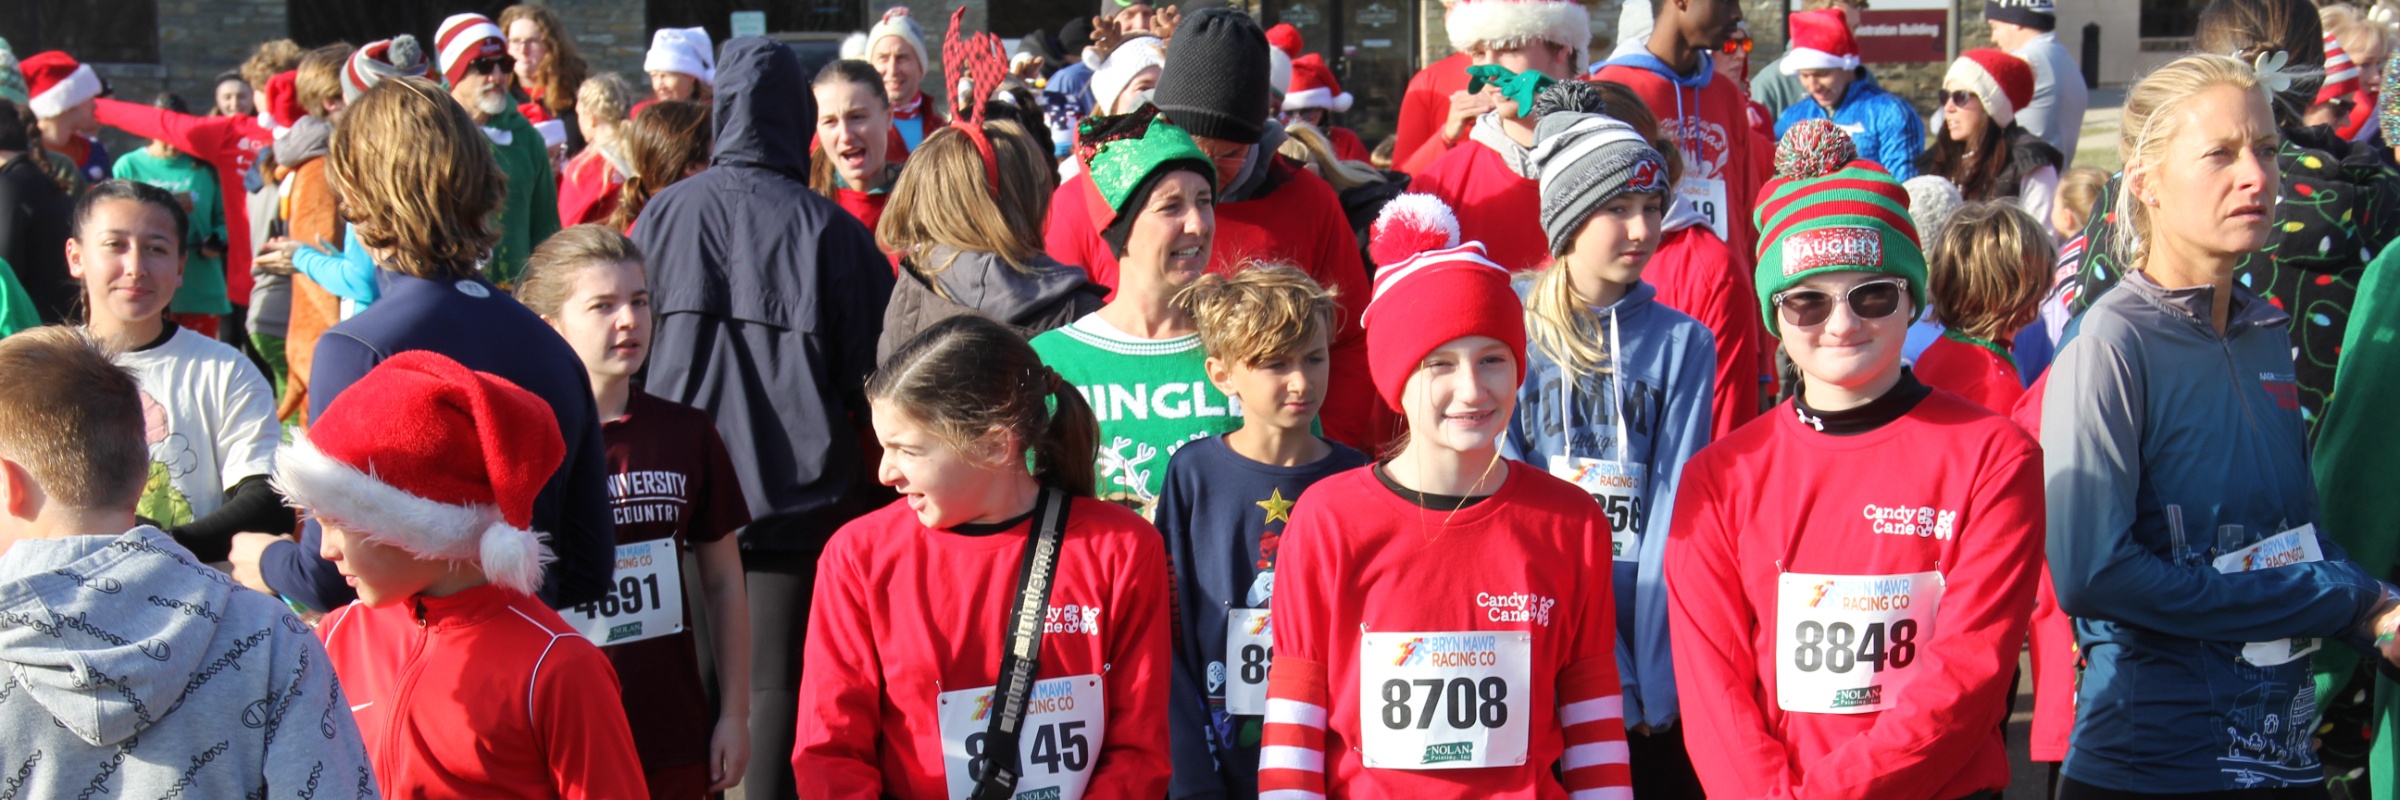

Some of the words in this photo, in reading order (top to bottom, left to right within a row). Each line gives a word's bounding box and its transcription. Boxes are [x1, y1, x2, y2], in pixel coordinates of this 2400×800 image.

[1784, 237, 1879, 262] NAUGHTY
[1076, 381, 1243, 421] INGL
[1569, 432, 1619, 457] Hilfige
[1600, 475, 1632, 488] RACING
[613, 504, 680, 525] COUNTRY
[1863, 504, 1916, 523] Candy
[1873, 519, 1916, 535] Cane
[640, 554, 653, 567] CO
[1013, 529, 1058, 639] lululemon
[1874, 578, 1910, 596] MAWR
[1476, 592, 1528, 610] Candy
[1842, 595, 1889, 611] RACING
[1892, 594, 1910, 610] CO
[1488, 608, 1530, 622] Cane
[1432, 637, 1461, 652] BRYN
[1463, 636, 1496, 651] MAWR
[1794, 619, 1917, 674] 8848
[1241, 644, 1273, 685] 8
[1432, 652, 1477, 667] RACING
[1479, 652, 1496, 667] CO
[1039, 680, 1073, 699] MAWR
[1841, 688, 1879, 700] NOLAN
[1058, 695, 1075, 711] CO
[1382, 676, 1508, 730] 8708
[965, 720, 1089, 783] 845
[1431, 744, 1470, 755] NOLAN
